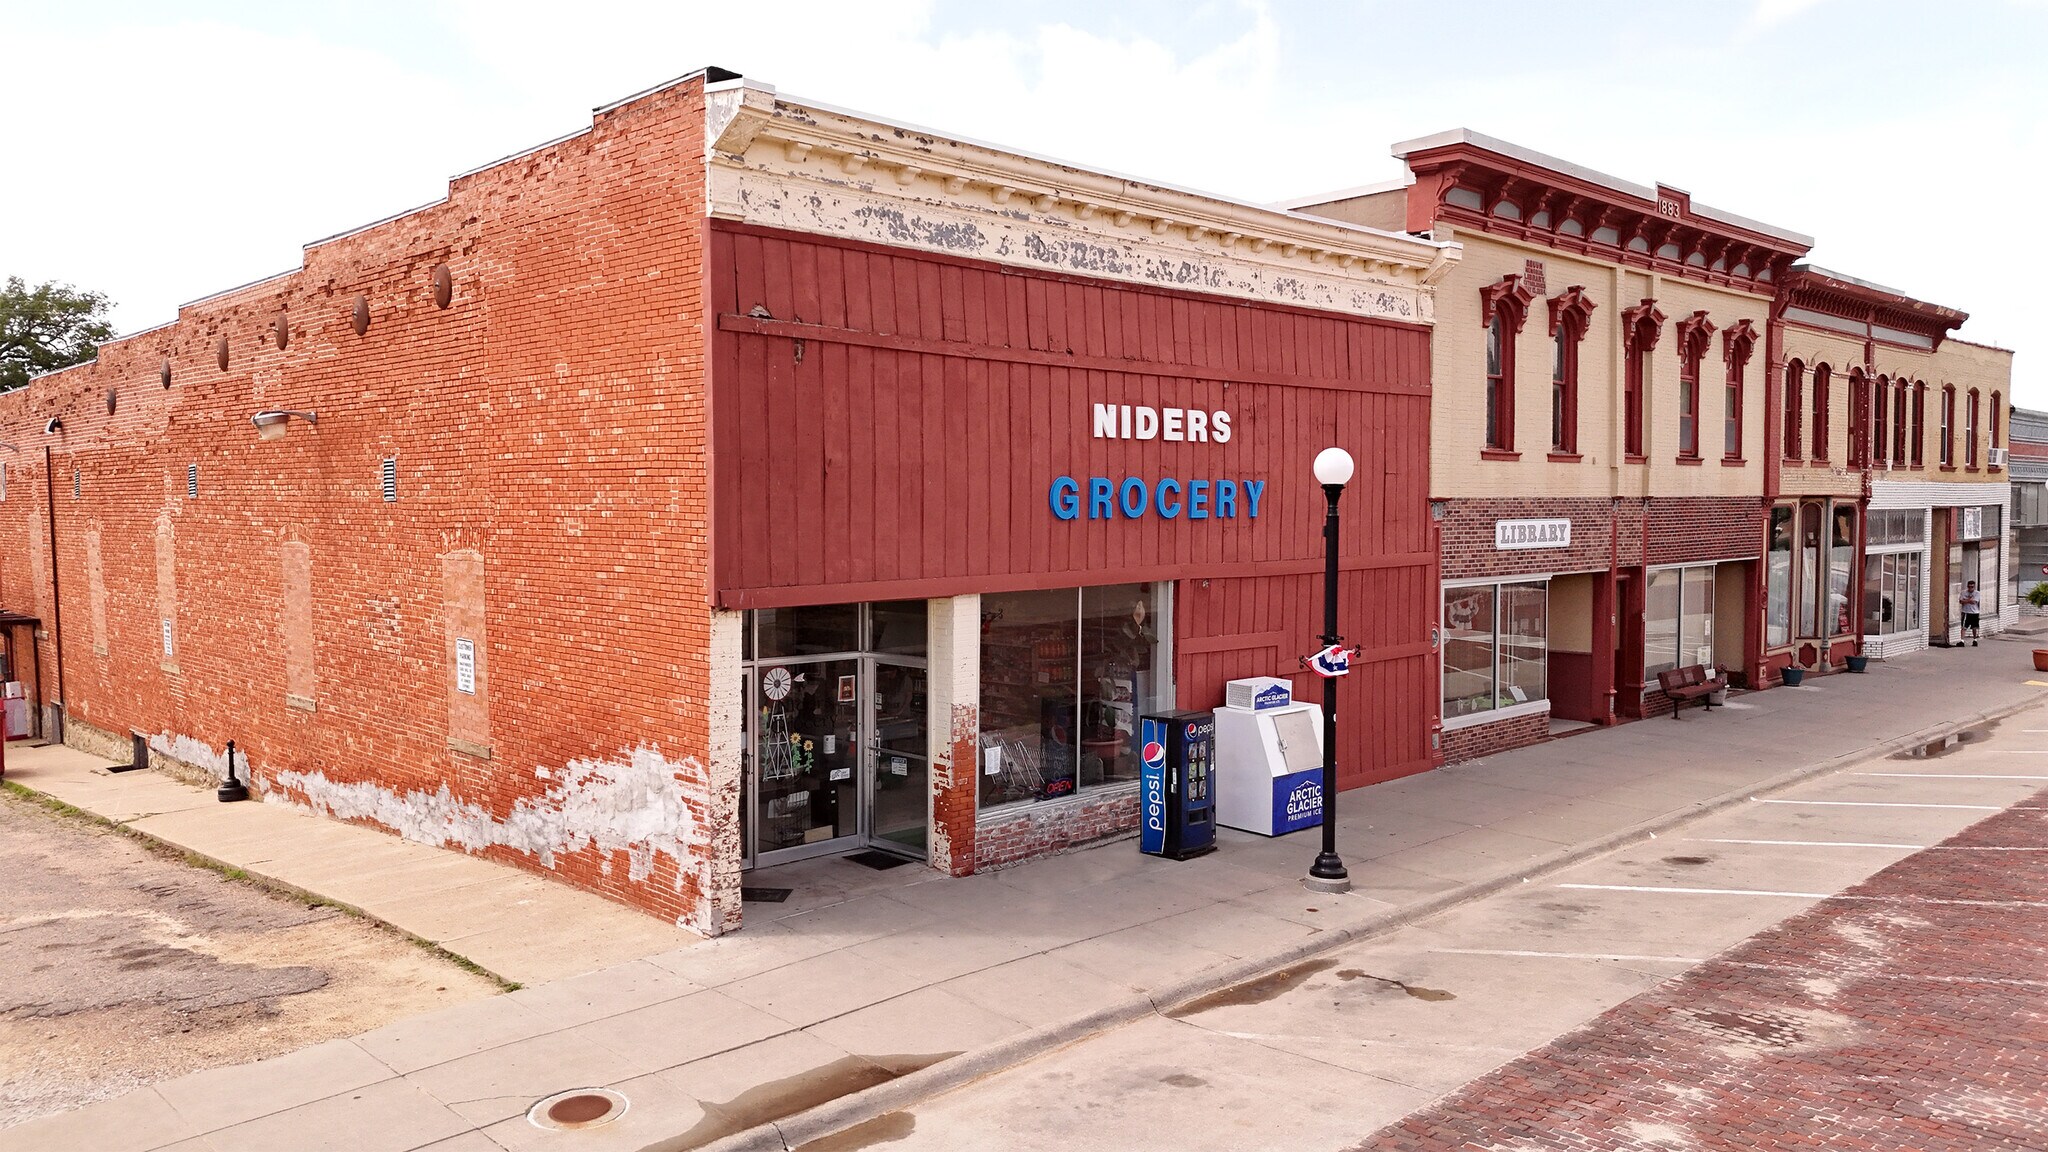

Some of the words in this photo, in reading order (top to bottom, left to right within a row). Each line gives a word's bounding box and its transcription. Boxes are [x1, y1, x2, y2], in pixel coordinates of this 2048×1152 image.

[1658, 199, 1680, 218] 1883
[1093, 403, 1231, 443] NIDERS
[1049, 476, 1265, 520] GROCERY
[1500, 524, 1567, 544] LIBRARY
[1047, 781, 1072, 794] OPEN
[1289, 785, 1321, 803] ARCTIC
[1146, 774, 1163, 831] pepsi
[1287, 796, 1323, 815] GLACIER
[1287, 811, 1312, 822] PREMIUM
